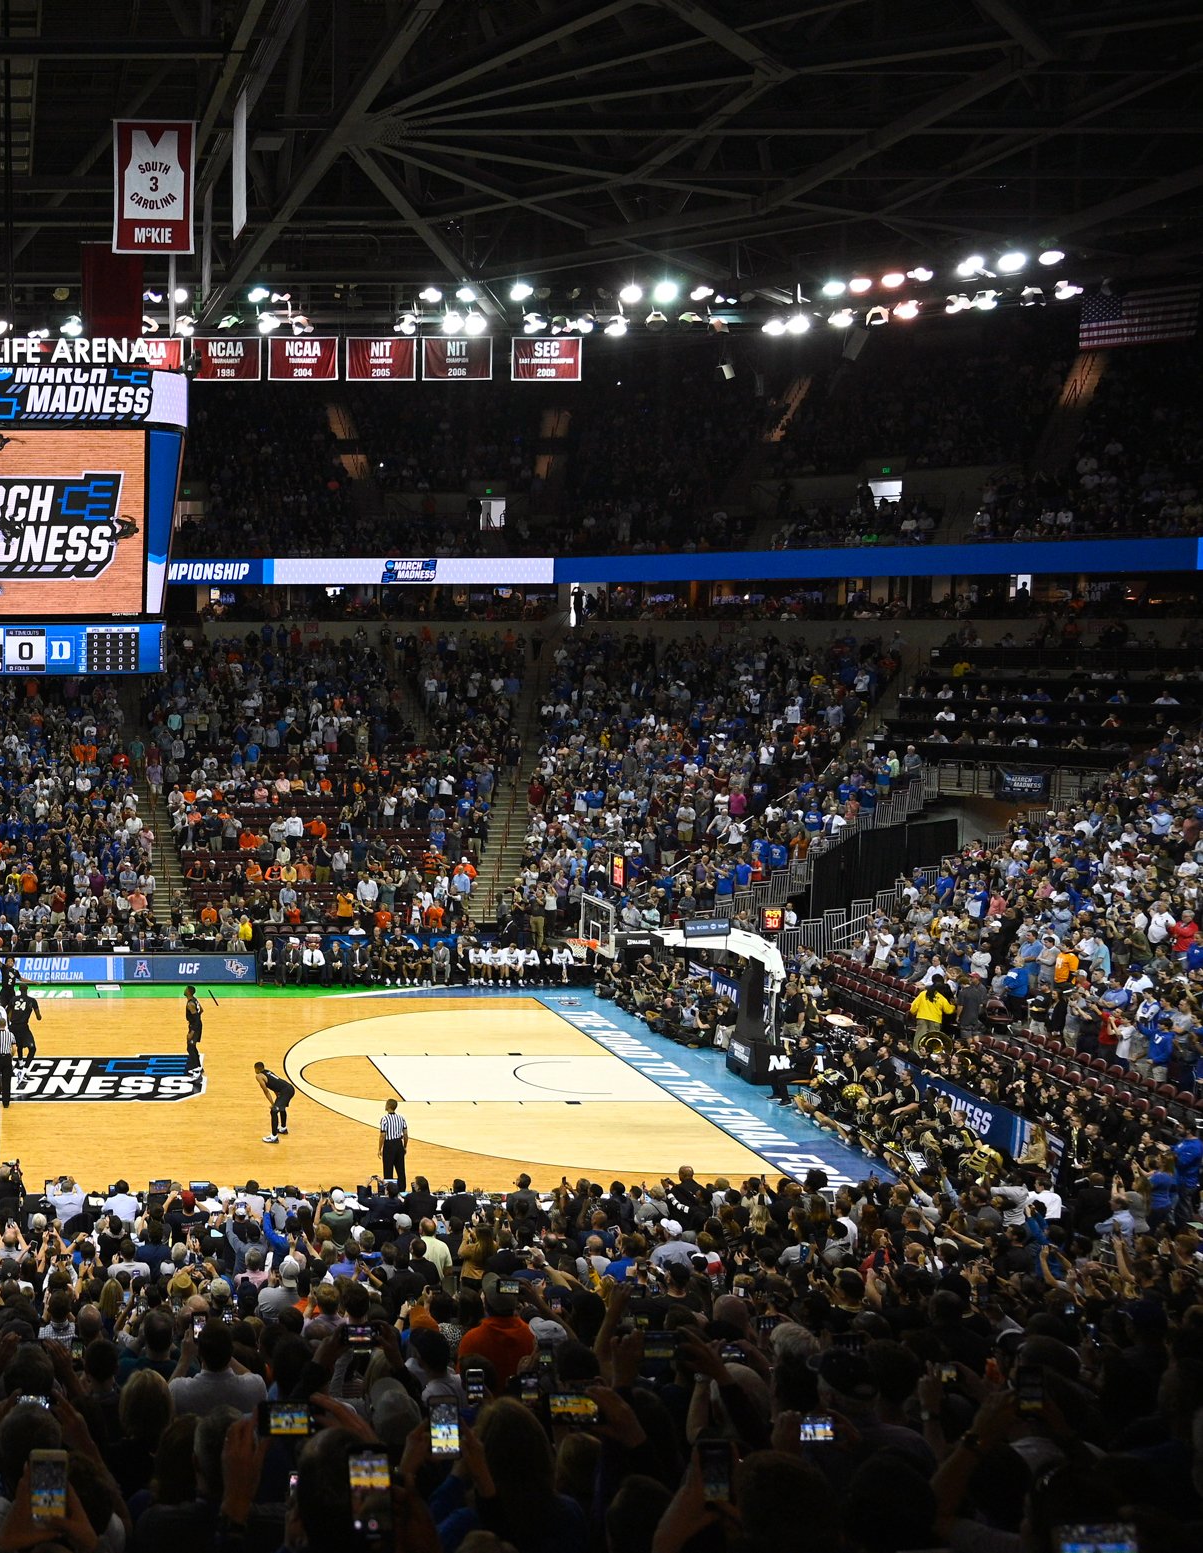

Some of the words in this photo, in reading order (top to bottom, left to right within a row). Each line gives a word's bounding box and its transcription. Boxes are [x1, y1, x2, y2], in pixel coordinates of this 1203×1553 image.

[138, 160, 171, 175] SOUTH
[149, 176, 159, 192] 3
[130, 191, 177, 210] CAROLINA
[50, 337, 151, 364] ARENA
[208, 341, 244, 356] NCAA
[285, 341, 321, 356] NCAA
[370, 341, 392, 357] NIT
[446, 341, 467, 357] NIT
[534, 341, 560, 357] SEC
[14, 368, 108, 384] MARCH
[216, 368, 235, 377] 1998
[293, 368, 312, 377] 2004
[371, 368, 391, 377] 2005
[447, 368, 466, 377] 2006
[537, 368, 556, 377] 2009
[25, 385, 151, 414] MADNESS
[394, 561, 422, 570] MARCH
[397, 570, 436, 579] MADNESS
[18, 642, 33, 661] 0
[50, 641, 71, 659] D
[765, 918, 779, 928] 30
[24, 957, 70, 971] ROUND
[178, 963, 200, 974] UCF
[223, 958, 249, 979] UCF
[44, 971, 84, 980] CAROLINA
[715, 981, 737, 1004] NCAA
[14, 1000, 27, 1011] 24
[559, 1010, 620, 1030] THE
[585, 1030, 664, 1060] ROAD
[631, 1061, 691, 1078] TO
[661, 1079, 735, 1105] THE
[697, 1106, 800, 1148] FINAL
